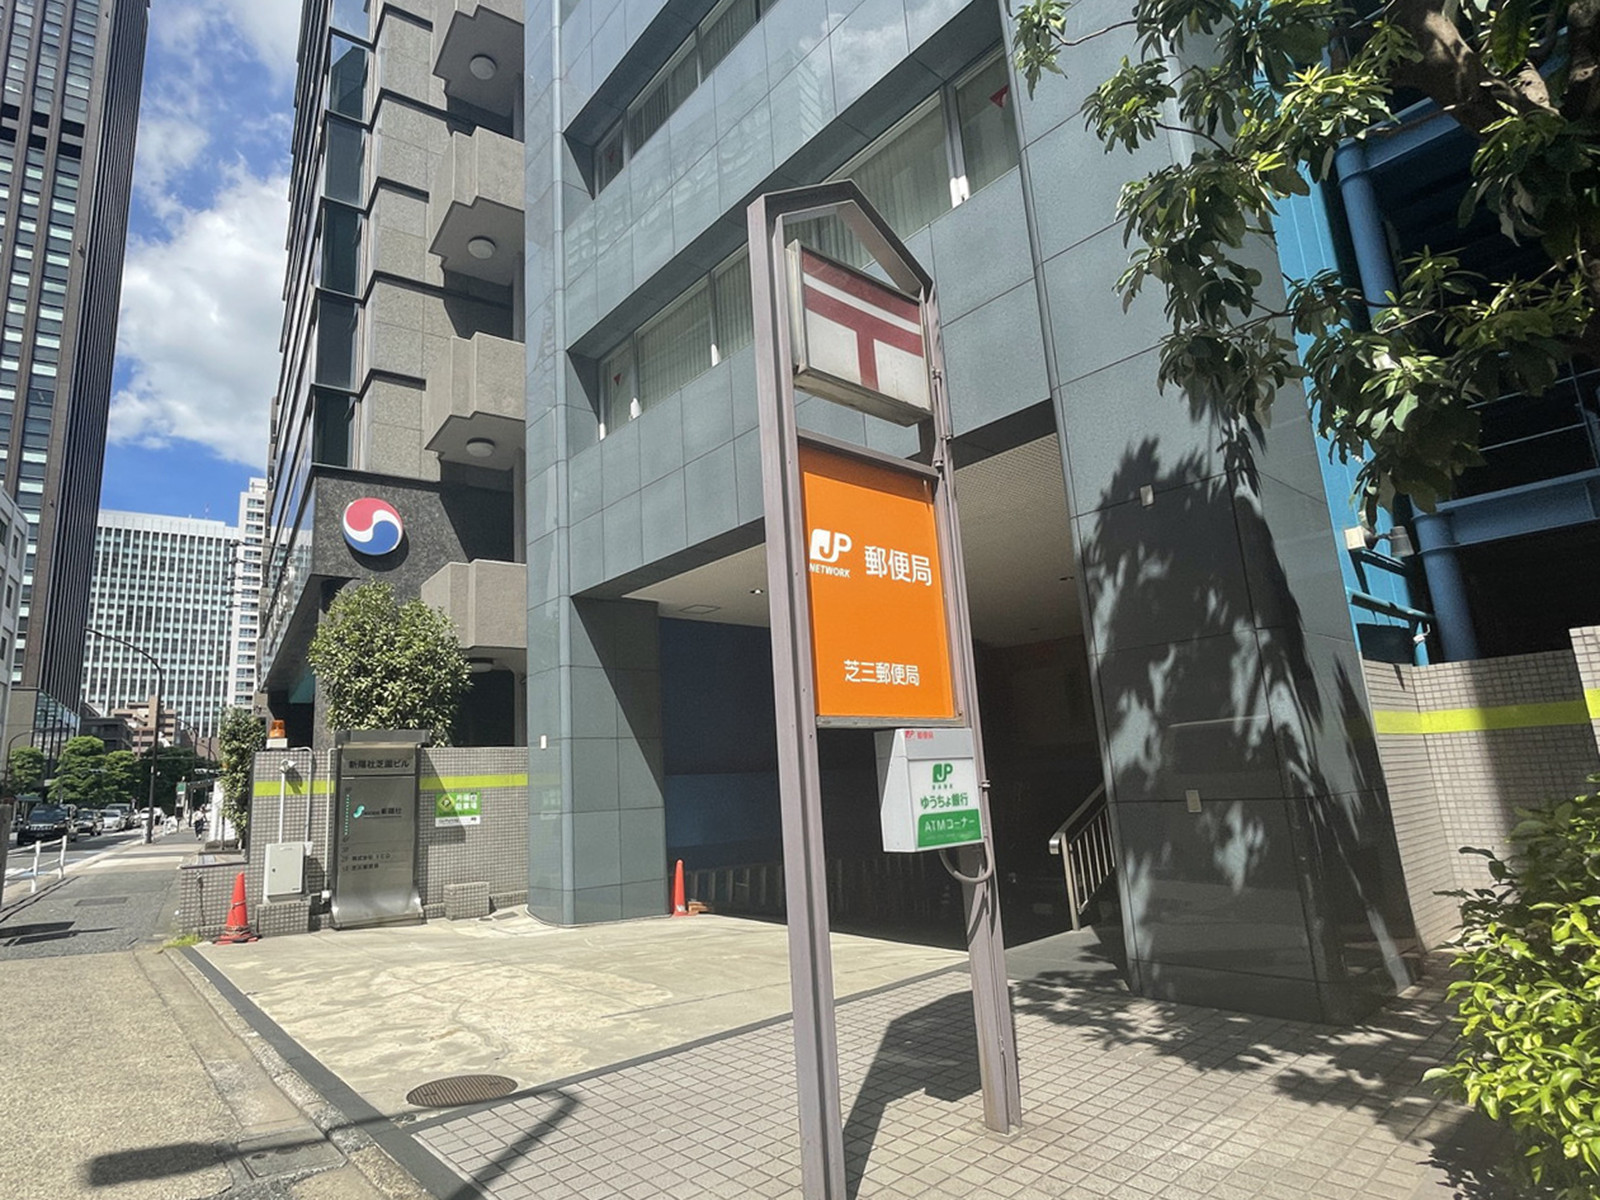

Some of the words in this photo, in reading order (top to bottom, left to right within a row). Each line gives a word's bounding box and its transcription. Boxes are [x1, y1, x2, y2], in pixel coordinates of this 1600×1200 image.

[810, 528, 852, 563] JP
[809, 563, 851, 578] NETWORK
[864, 545, 933, 586] 郵便局
[844, 659, 920, 687] 芝三郵便局
[932, 763, 953, 783] JP
[920, 792, 968, 809] ゆうちょ銀行
[924, 816, 976, 832] ATMコーナー
